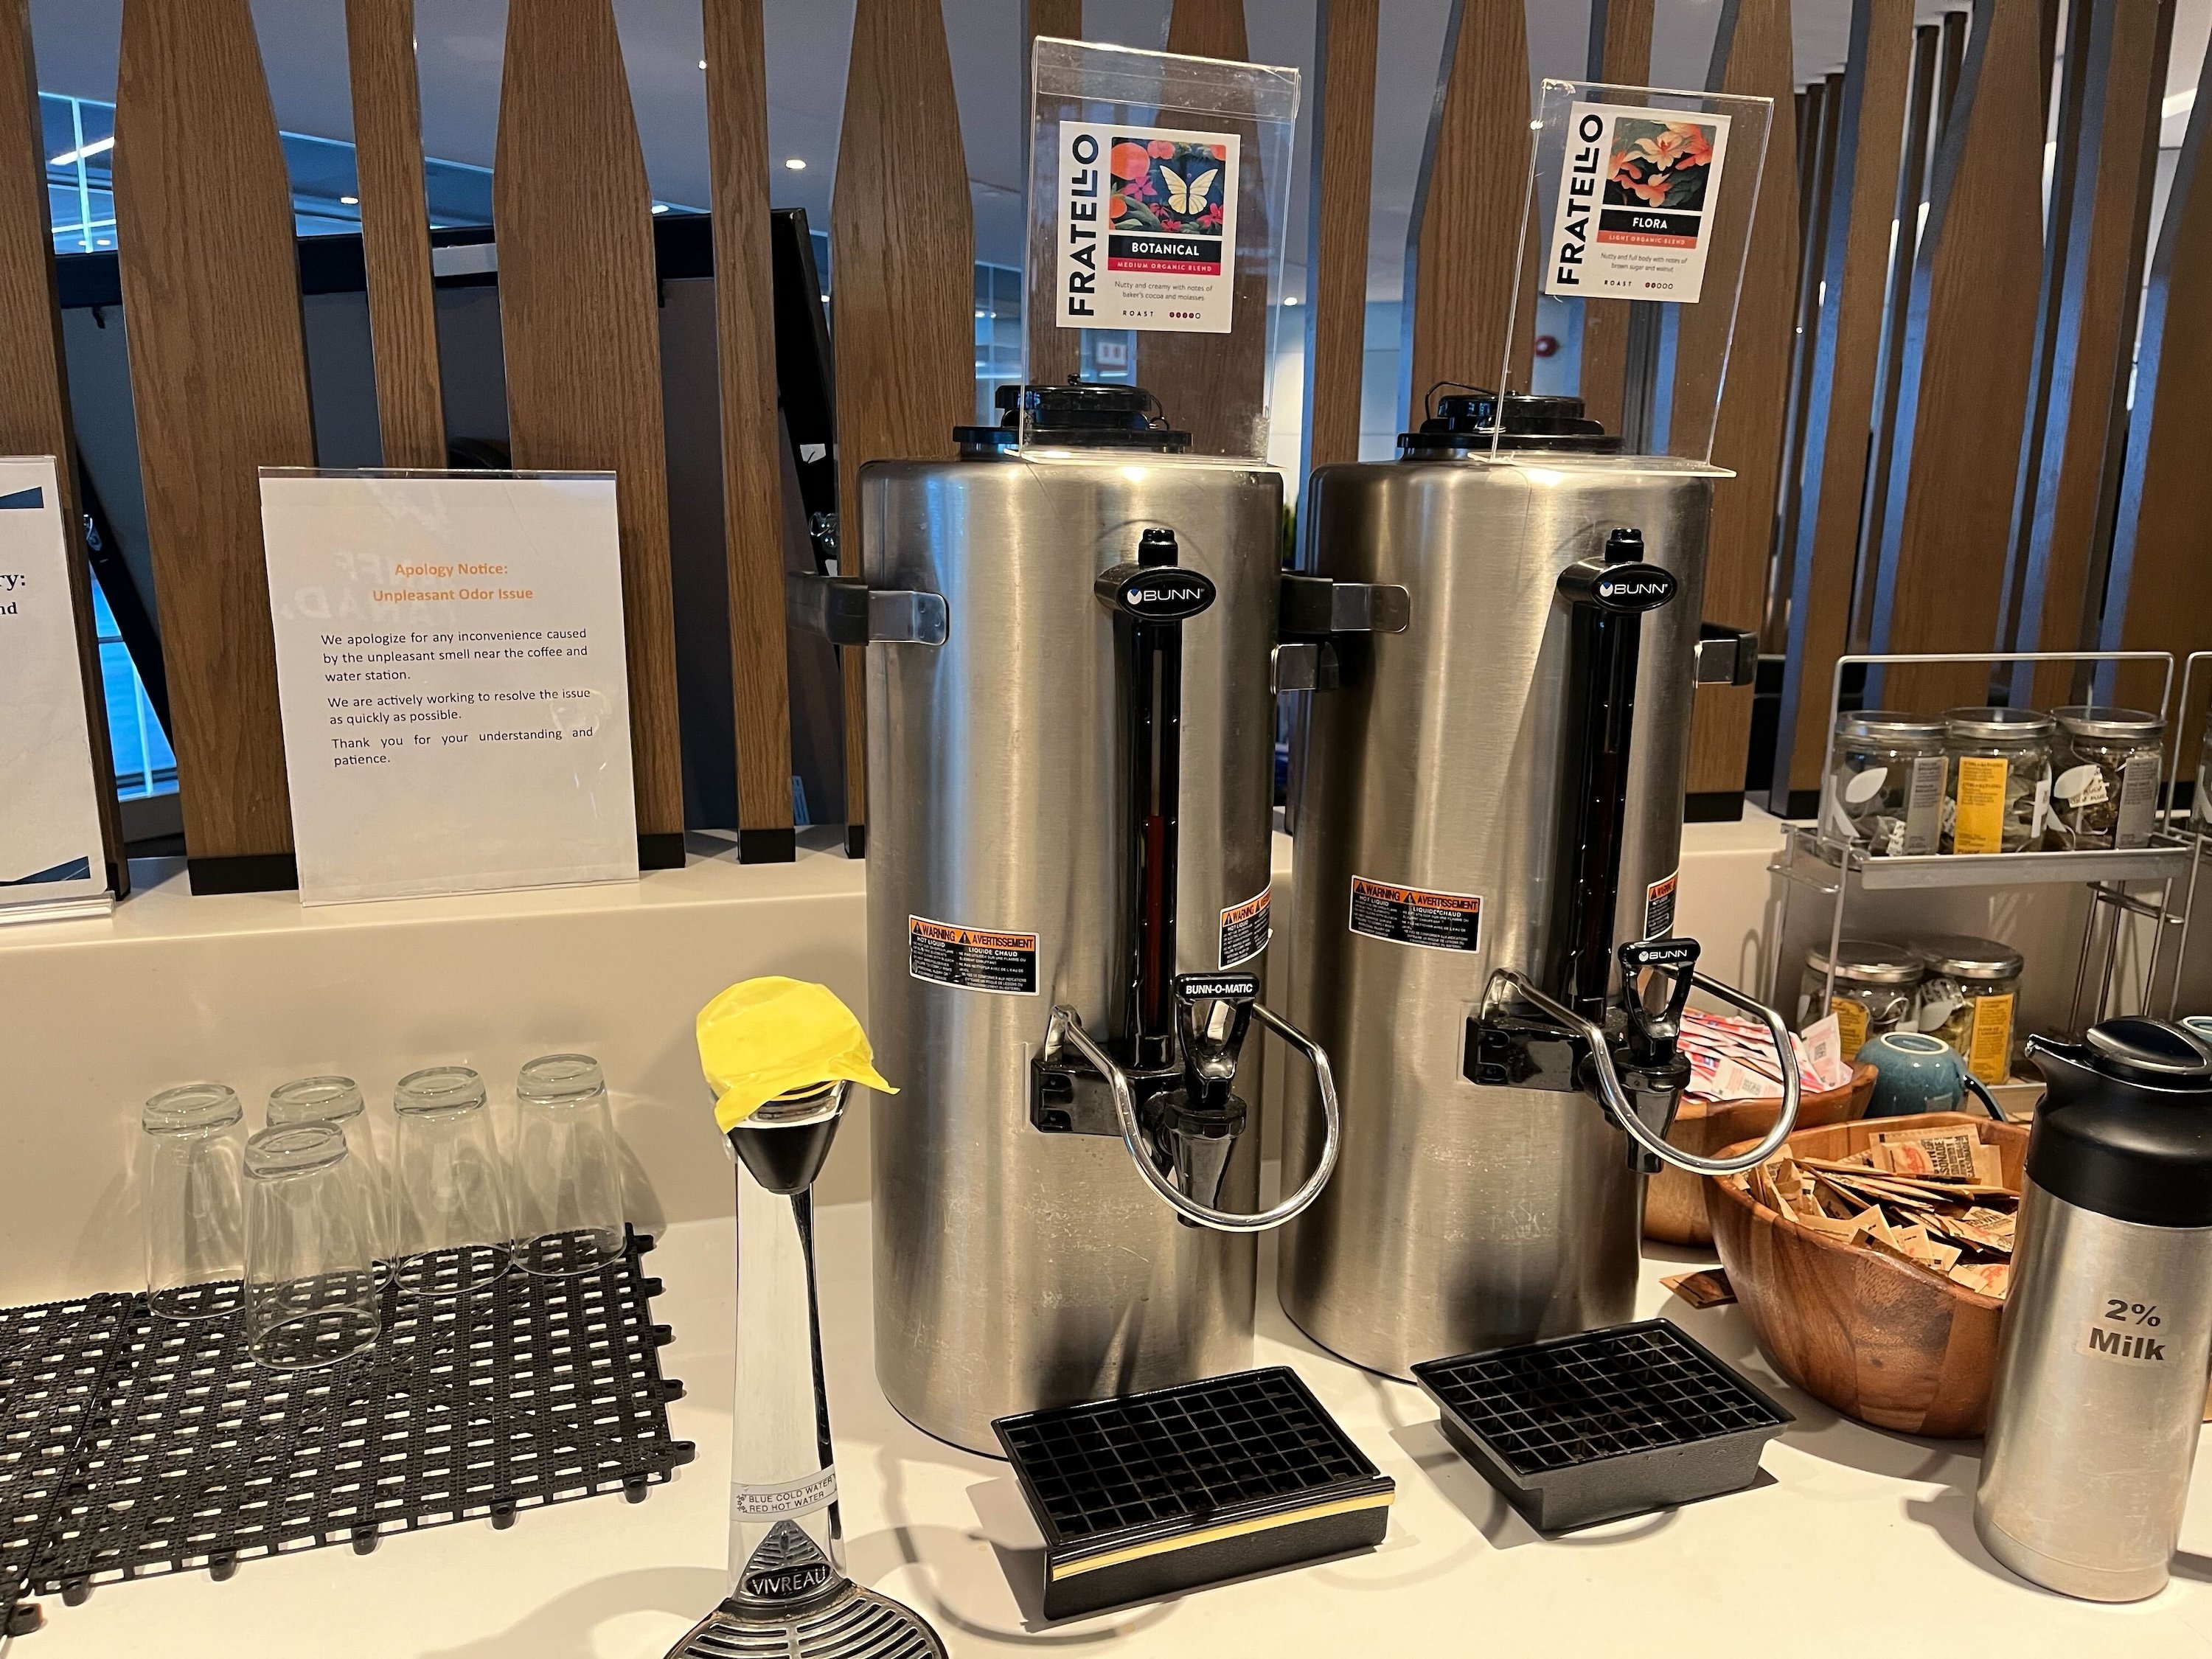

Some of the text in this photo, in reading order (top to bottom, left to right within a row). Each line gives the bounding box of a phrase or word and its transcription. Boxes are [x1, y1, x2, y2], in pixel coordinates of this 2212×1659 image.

[1557, 114, 1603, 285] FRATELLO
[1068, 134, 1099, 316] FRATELLO
[1632, 217, 1667, 229] FLORA
[1132, 242, 1200, 256] BOTANICAL
[1601, 252, 1616, 260] Nutty
[1115, 281, 1133, 289] Nutty
[395, 563, 508, 577] Apology Notice:
[373, 588, 533, 603] Unpleasant Odor Issue
[1144, 588, 1200, 601] BUNN
[1614, 583, 1665, 594] BUNN
[321, 628, 586, 647] We apologize for any inconvenience caused
[324, 646, 587, 664] by the unpleasant smell near the coffee and
[325, 670, 410, 682] water station.
[328, 689, 590, 708] We are actively working to resolve the issue
[330, 710, 461, 726] as quickly as possible.
[332, 727, 593, 748] Thank you for your understanding and
[335, 754, 390, 767] patience.
[1360, 895, 1389, 907] HOT LIQUID
[1366, 884, 1478, 911] WARNING AVERTISSEMENT
[1233, 905, 1254, 922] WARNING
[1413, 906, 1436, 914] LIQUIDE
[917, 936, 946, 948] HOT LIQUID
[922, 924, 1034, 949] WARNING AVERTISSEMENT
[968, 947, 1018, 957] LIQUIDE CHAUD
[1649, 950, 1687, 960] BUNN
[1186, 984, 1253, 994] BUNN-O-MATIC
[2104, 1299, 2161, 1327] 2%
[2089, 1327, 2166, 1361] Milk
[776, 1490, 802, 1502] COLD
[805, 1477, 832, 1494] WATER
[772, 1502, 790, 1511] HOT
[794, 1491, 824, 1506] WATER
[752, 1565, 826, 1595] VIVREAU
